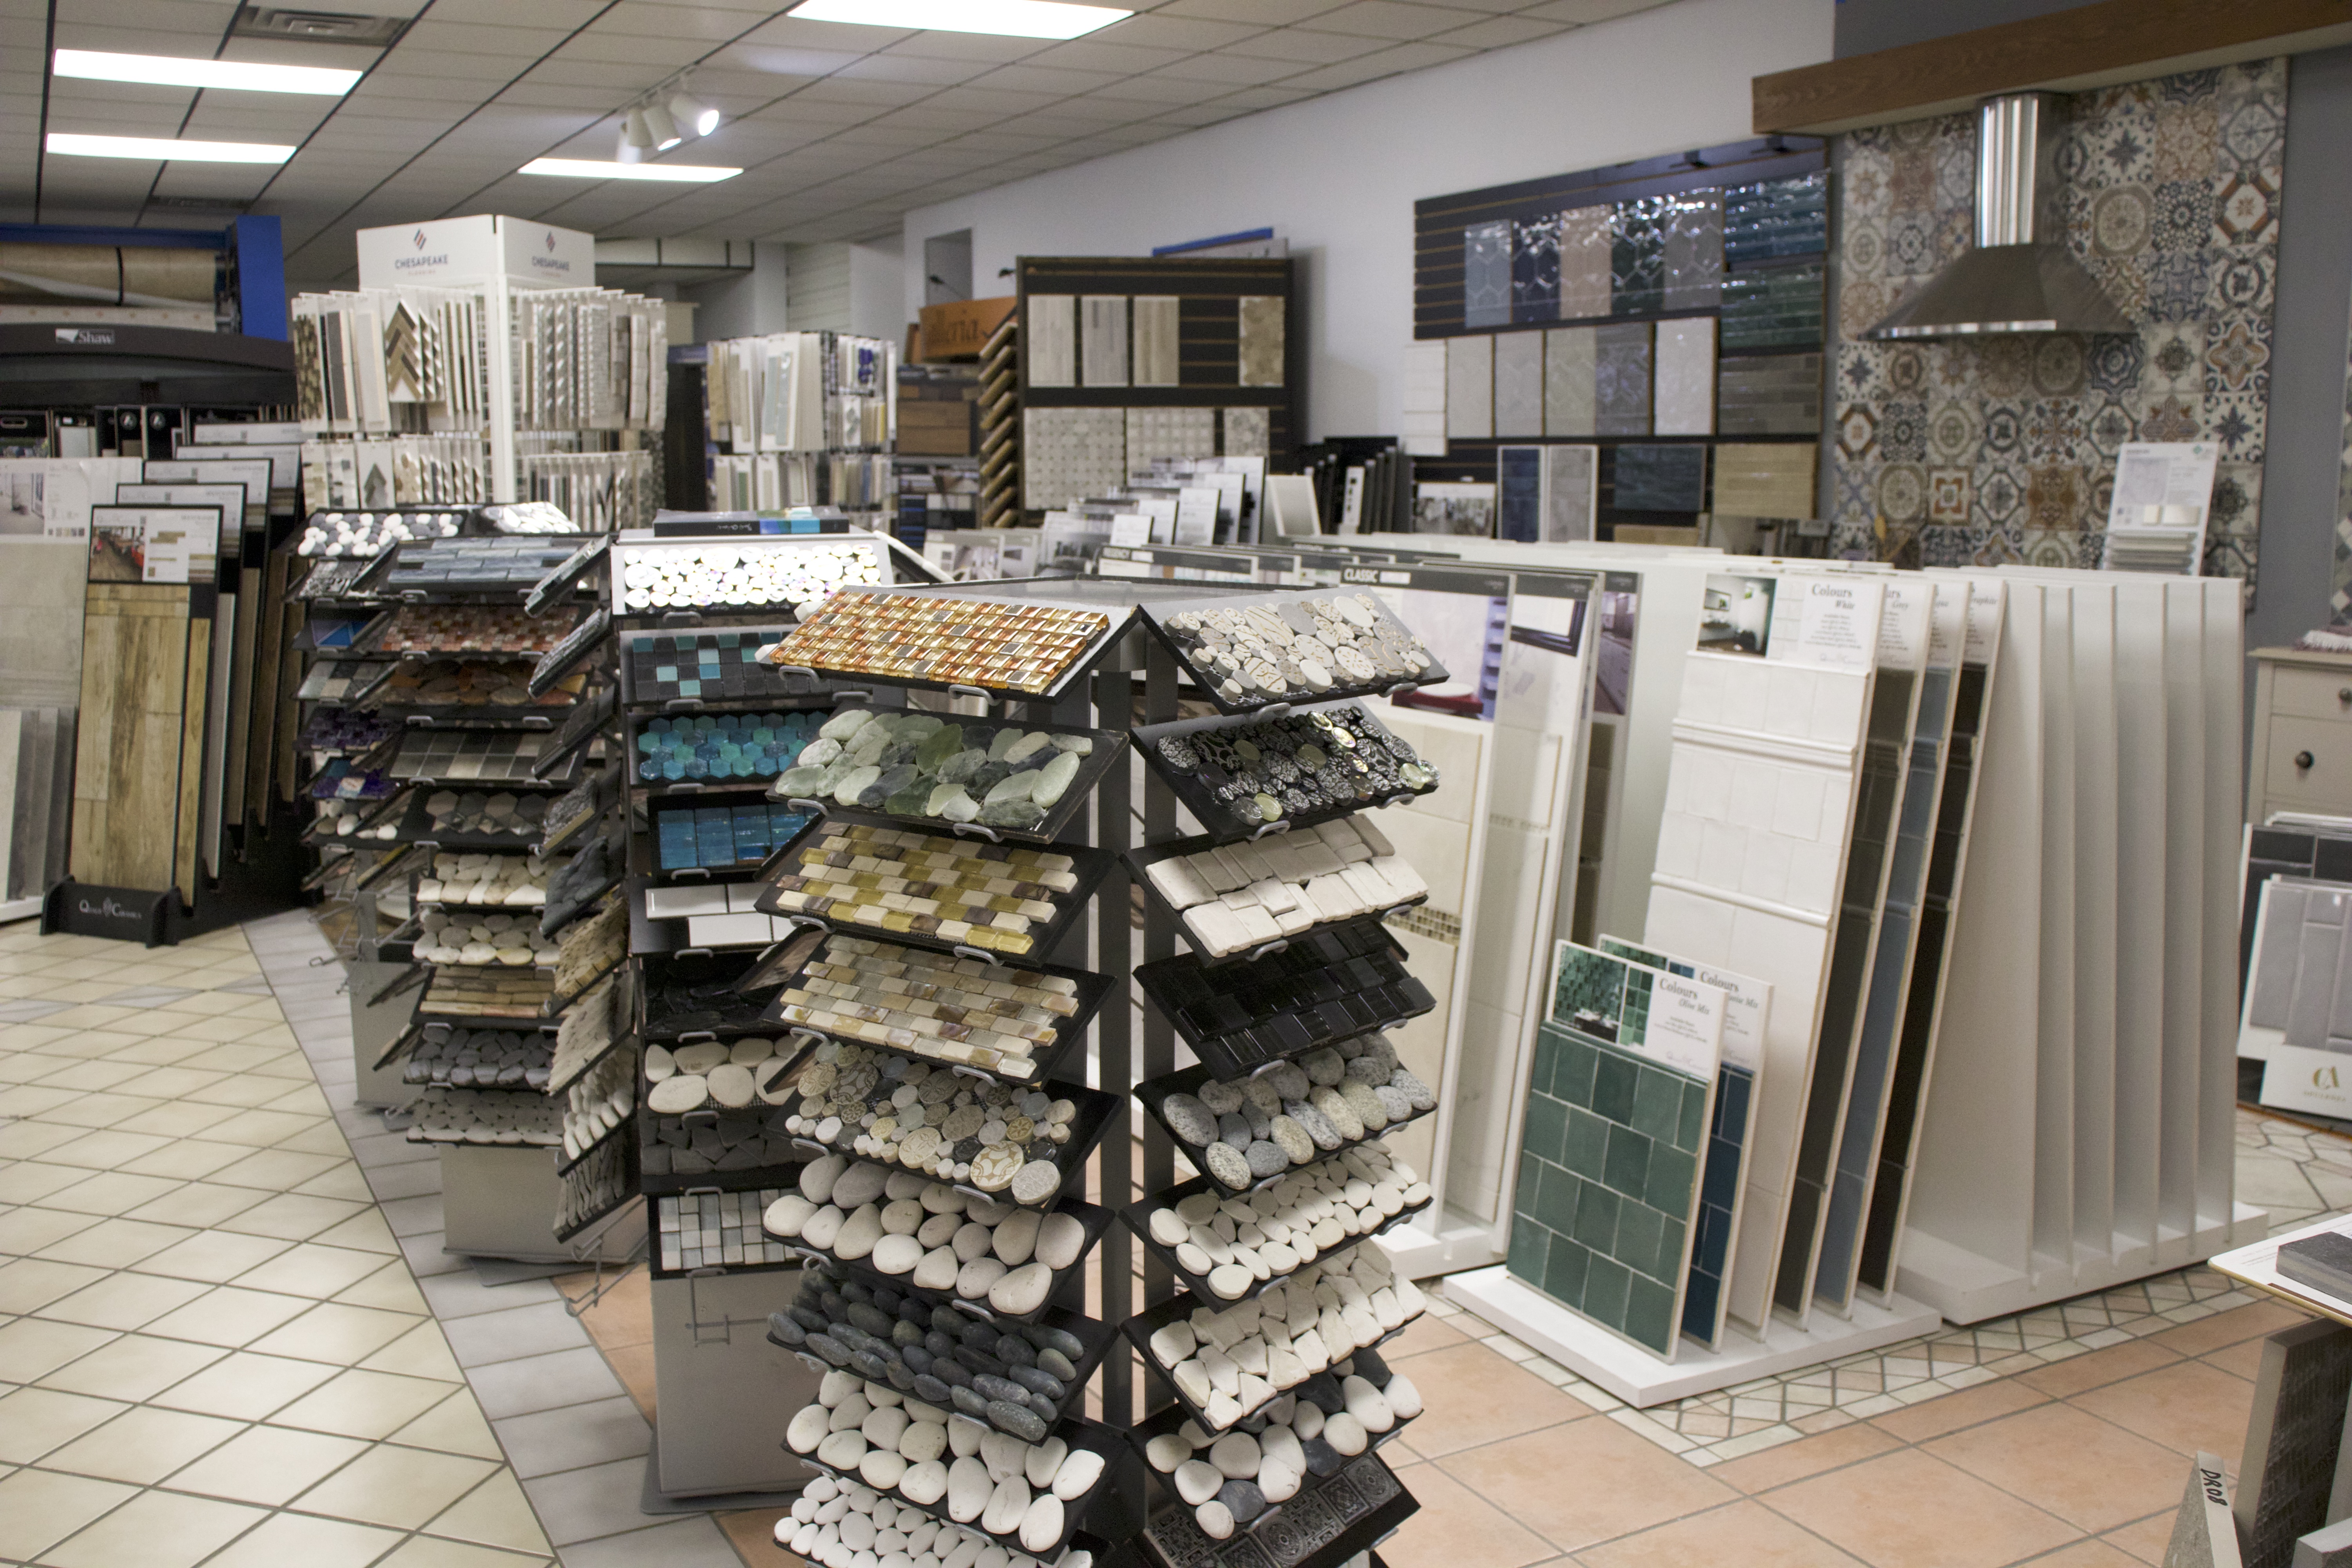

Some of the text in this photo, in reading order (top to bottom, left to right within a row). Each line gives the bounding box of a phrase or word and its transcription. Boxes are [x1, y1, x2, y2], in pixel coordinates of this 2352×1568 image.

[395, 255, 448, 269] CHESAPEAKE
[79, 330, 114, 343] Shaw
[1344, 568, 1378, 583] CLASSIC
[1812, 583, 1852, 598] Colours
[1835, 599, 1855, 609] White
[1659, 978, 1698, 999] Colours
[1700, 971, 1739, 992] Colours
[2200, 1468, 2227, 1505] DR08
